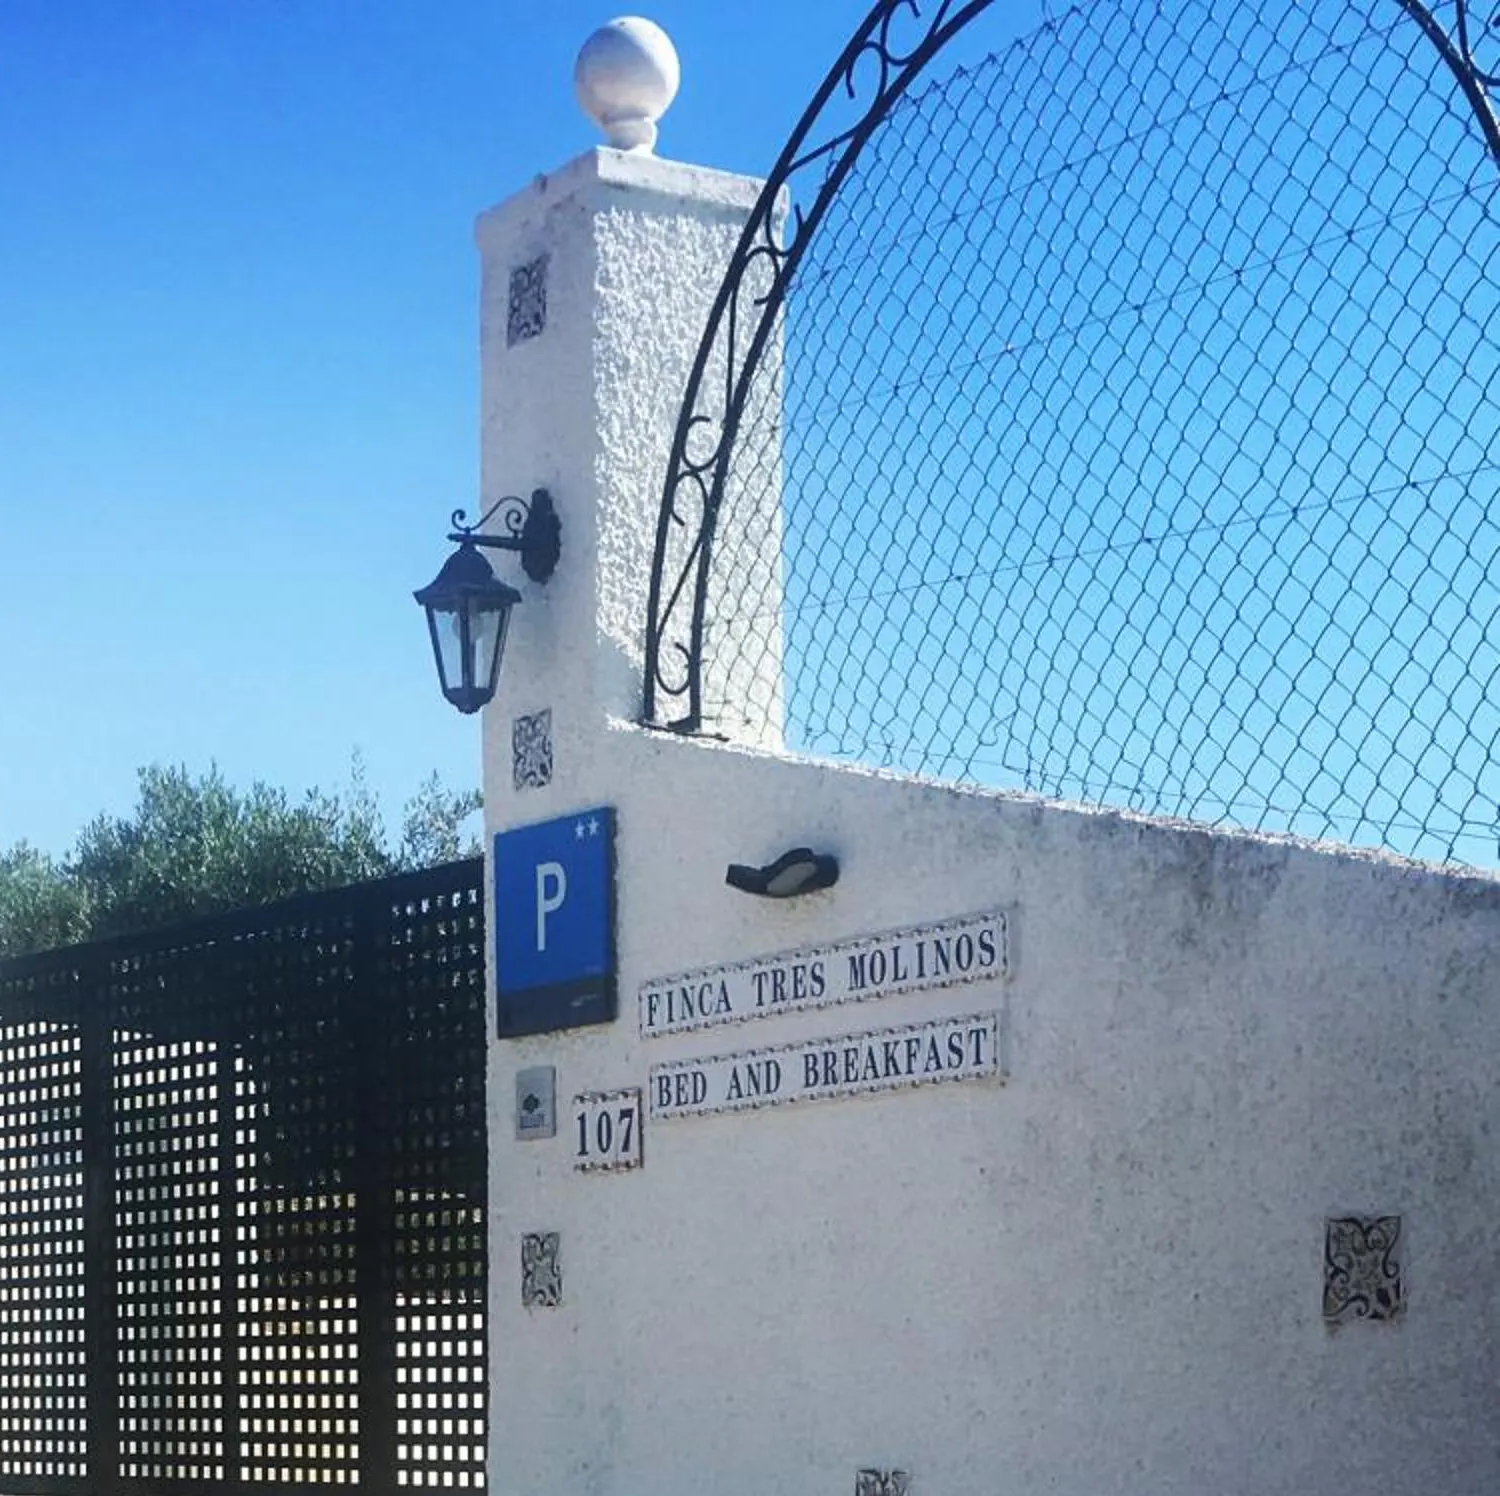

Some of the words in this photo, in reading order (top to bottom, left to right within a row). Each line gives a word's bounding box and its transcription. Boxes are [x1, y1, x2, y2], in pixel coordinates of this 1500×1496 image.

[535, 861, 568, 953] P
[647, 980, 732, 1027] FINCA
[752, 964, 827, 1007] TRES
[847, 928, 997, 991] MOLINOS
[657, 1071, 708, 1108] BED
[726, 1060, 781, 1101] AND
[803, 1027, 989, 1088] BREAKFAST
[577, 1108, 635, 1156] 107
